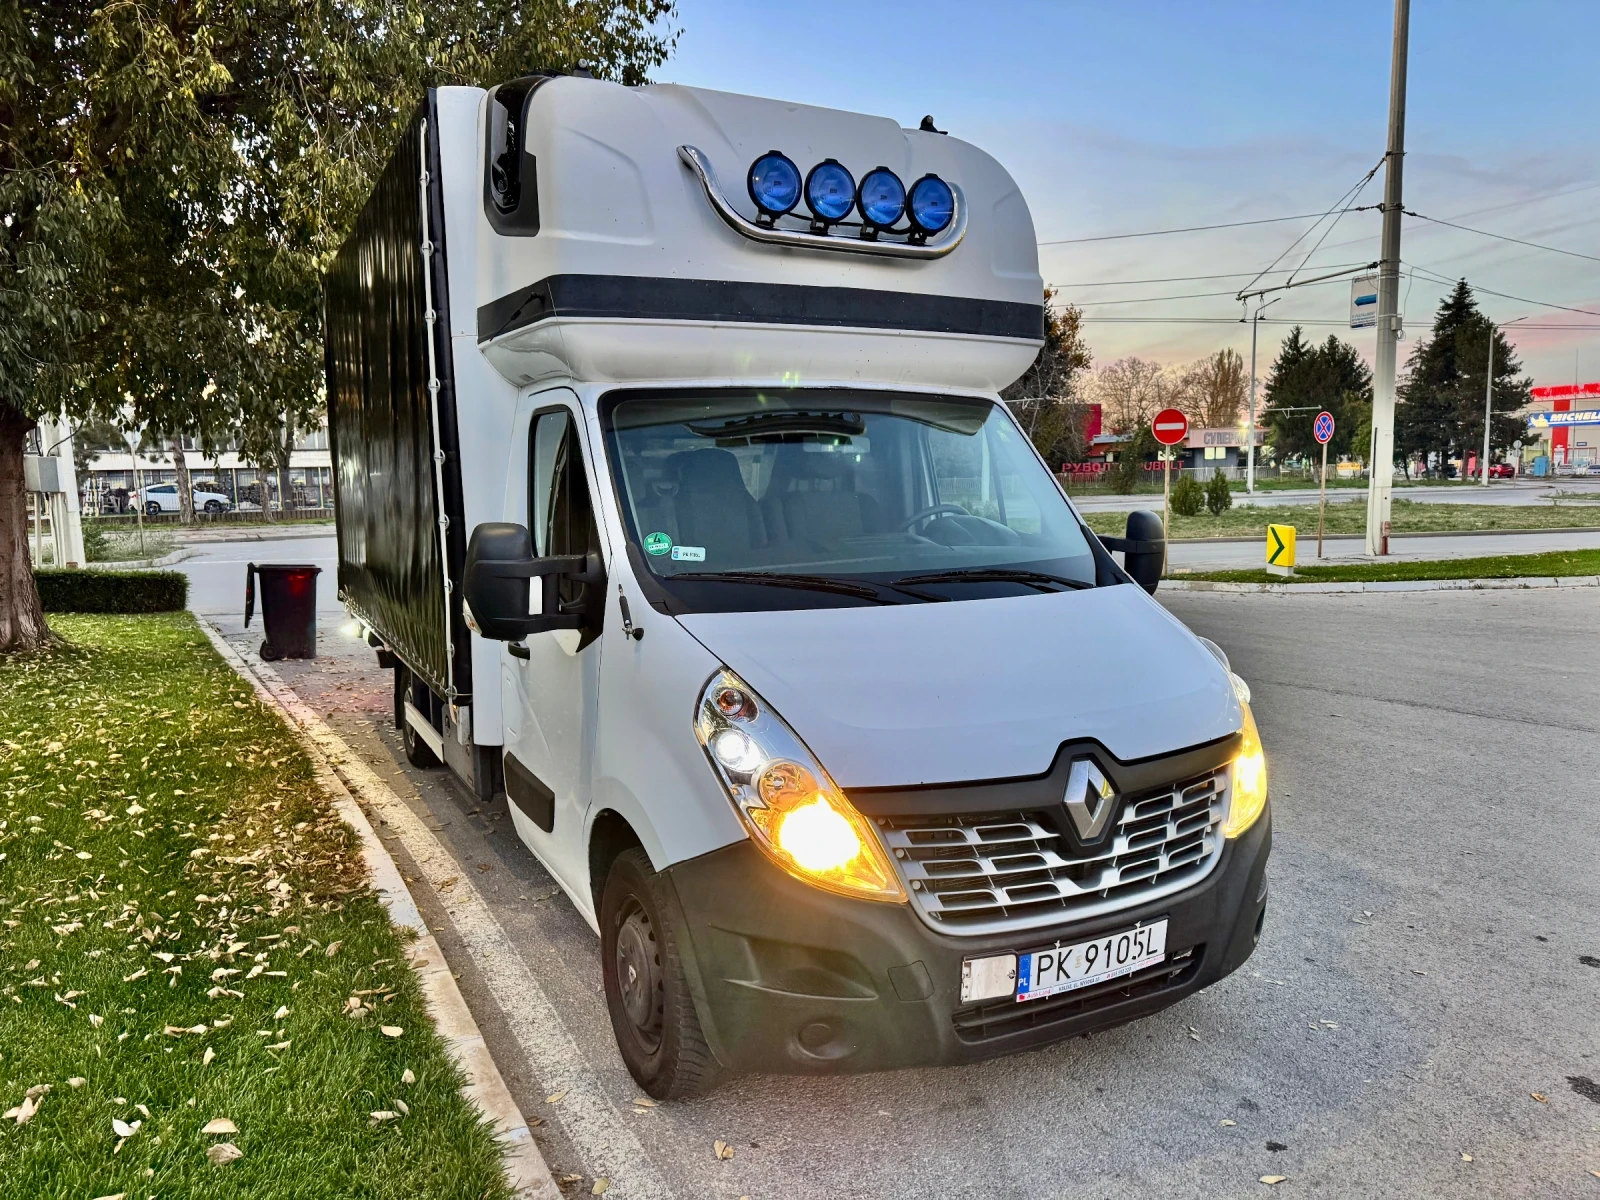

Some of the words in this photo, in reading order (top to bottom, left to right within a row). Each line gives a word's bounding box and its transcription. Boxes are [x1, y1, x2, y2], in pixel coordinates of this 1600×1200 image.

[1061, 462, 1119, 473] РУБОЛ
[1137, 460, 1184, 471] UBOLT
[653, 533, 661, 544] 4
[1036, 949, 1073, 986] PK
[1084, 927, 1158, 975] 9105L
[1018, 977, 1028, 988] PL
